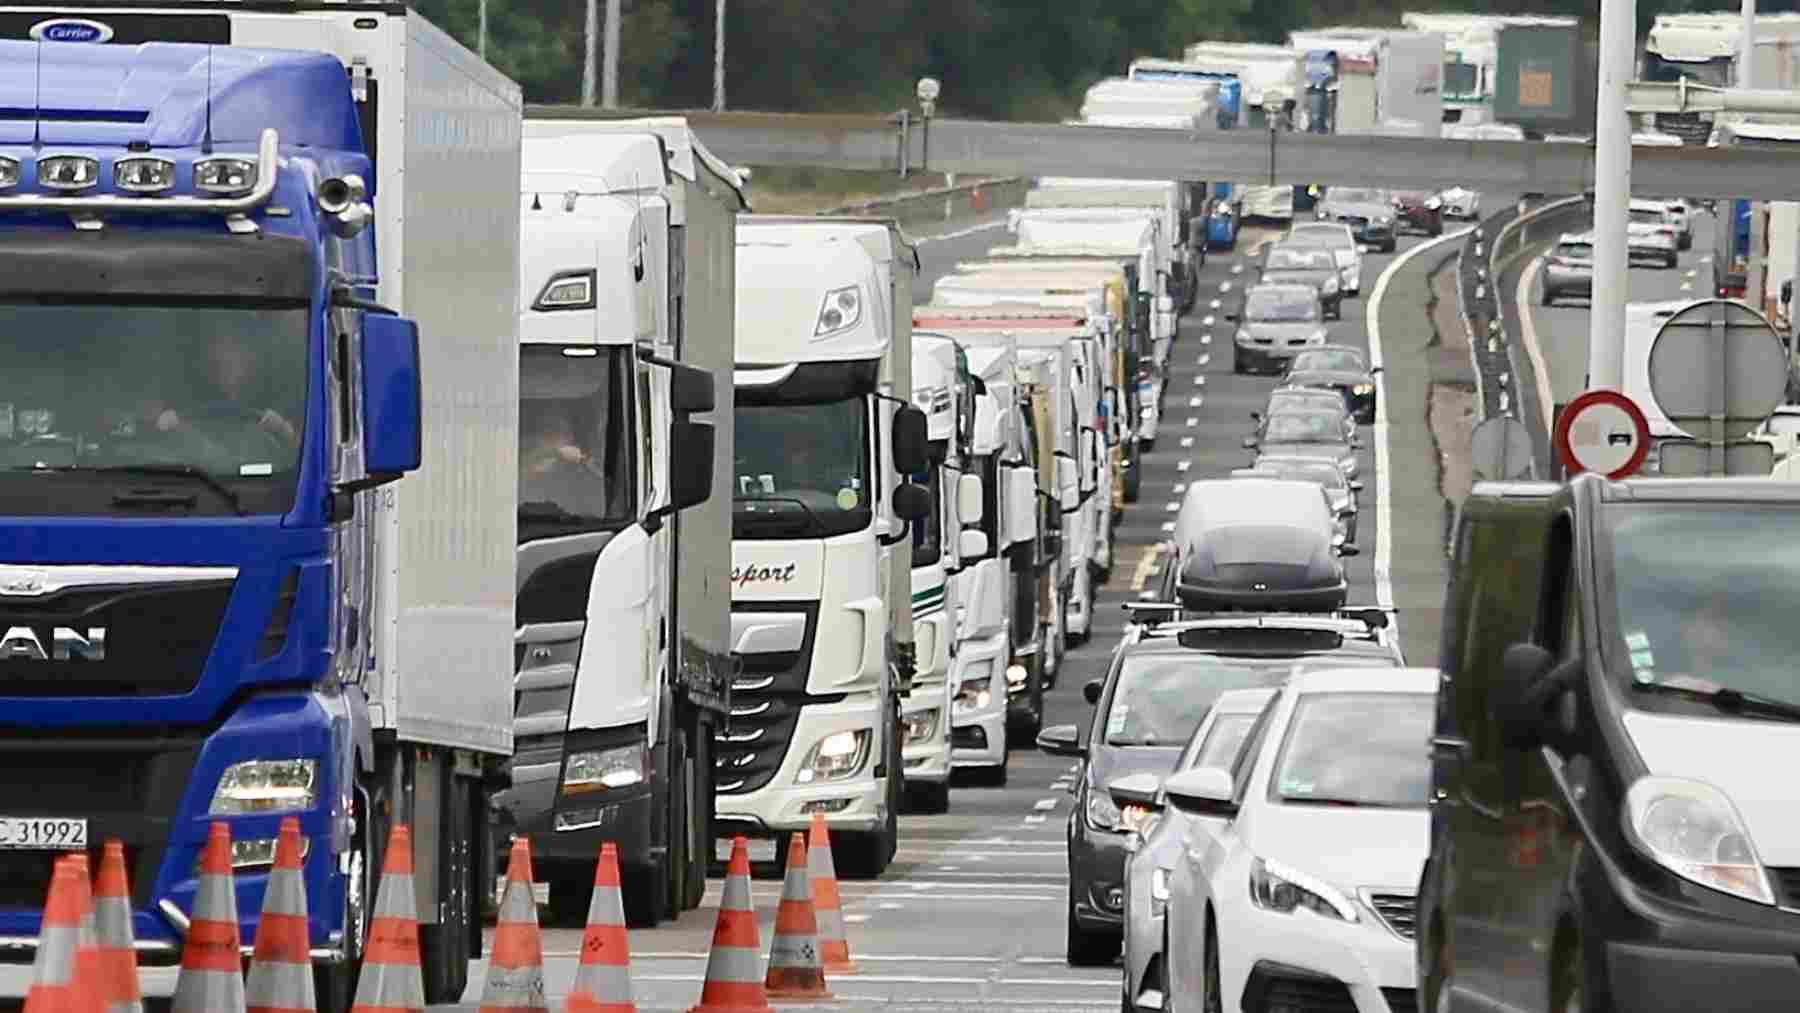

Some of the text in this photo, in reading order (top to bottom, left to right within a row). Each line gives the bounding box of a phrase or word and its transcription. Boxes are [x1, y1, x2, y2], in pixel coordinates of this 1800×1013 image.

[49, 26, 95, 38] Carrier
[730, 561, 795, 588] sport
[17, 821, 84, 843] 31992
